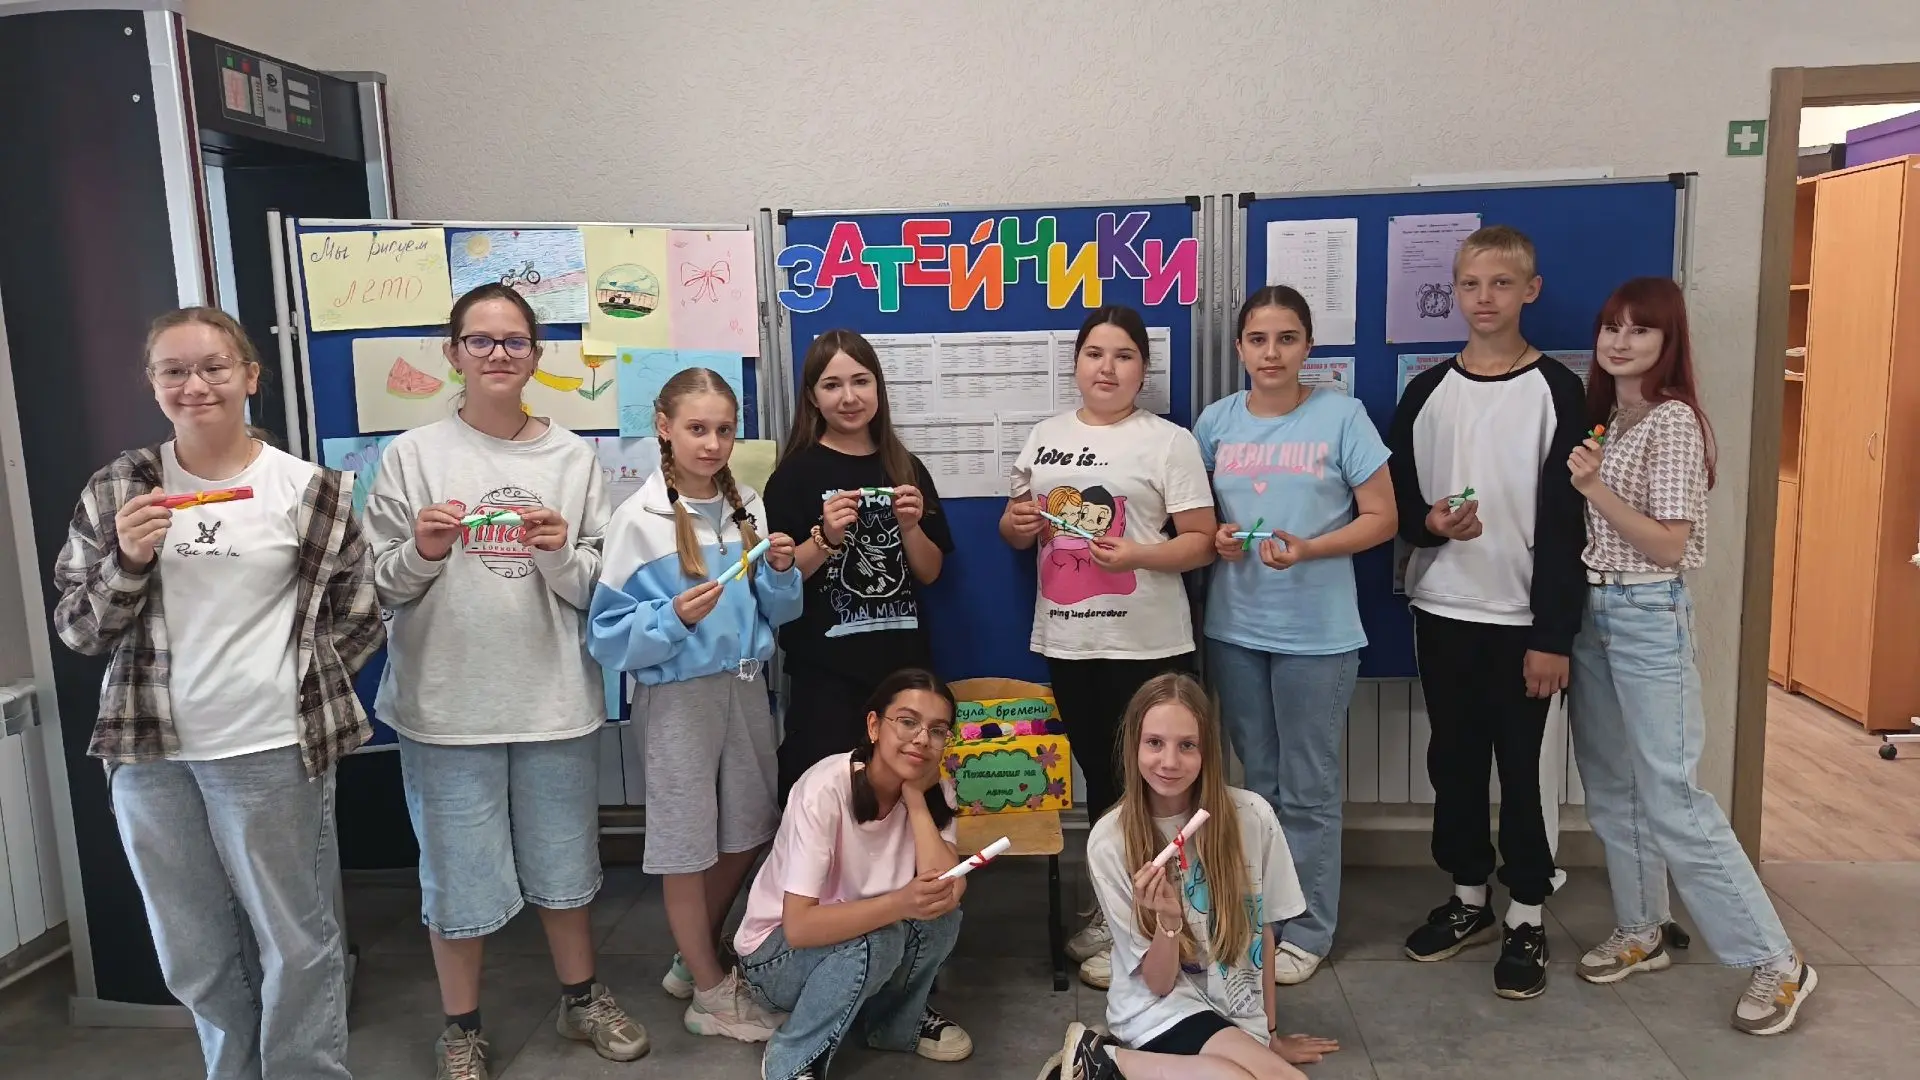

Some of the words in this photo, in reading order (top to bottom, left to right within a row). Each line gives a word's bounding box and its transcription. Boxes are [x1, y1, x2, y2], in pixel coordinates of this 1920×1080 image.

[310, 236, 350, 262] Мы
[777, 211, 1199, 313] ЗАТЕЙНИКИ
[1034, 446, 1074, 466] love
[876, 600, 917, 619] MATCH
[956, 706, 985, 719] сула
[996, 705, 1048, 719] времени
[963, 770, 1020, 778] Пожелания
